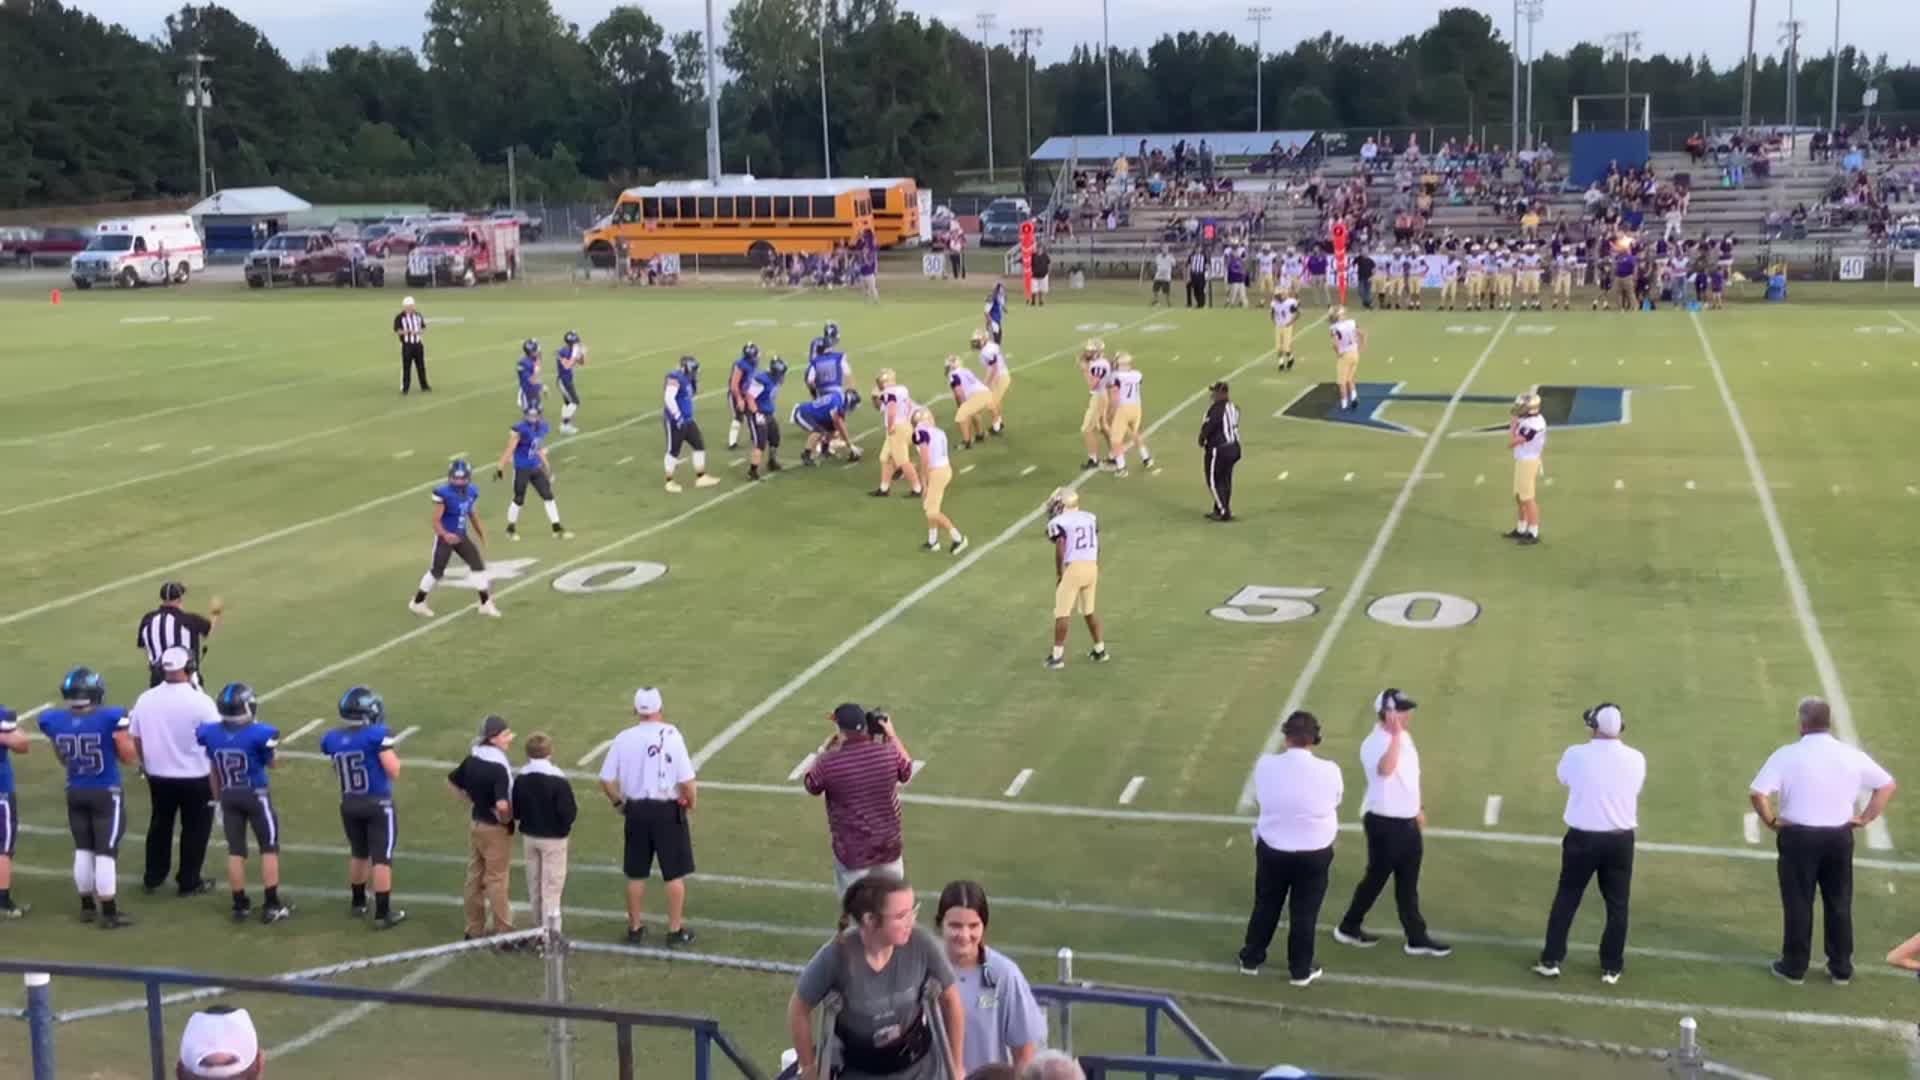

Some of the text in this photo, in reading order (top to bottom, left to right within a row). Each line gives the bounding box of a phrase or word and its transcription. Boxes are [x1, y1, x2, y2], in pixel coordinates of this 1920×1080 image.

[1843, 259, 1862, 275] 40
[1075, 526, 1095, 550] 21
[56, 733, 105, 776] 25
[213, 750, 249, 790] 12
[333, 751, 370, 795] 16
